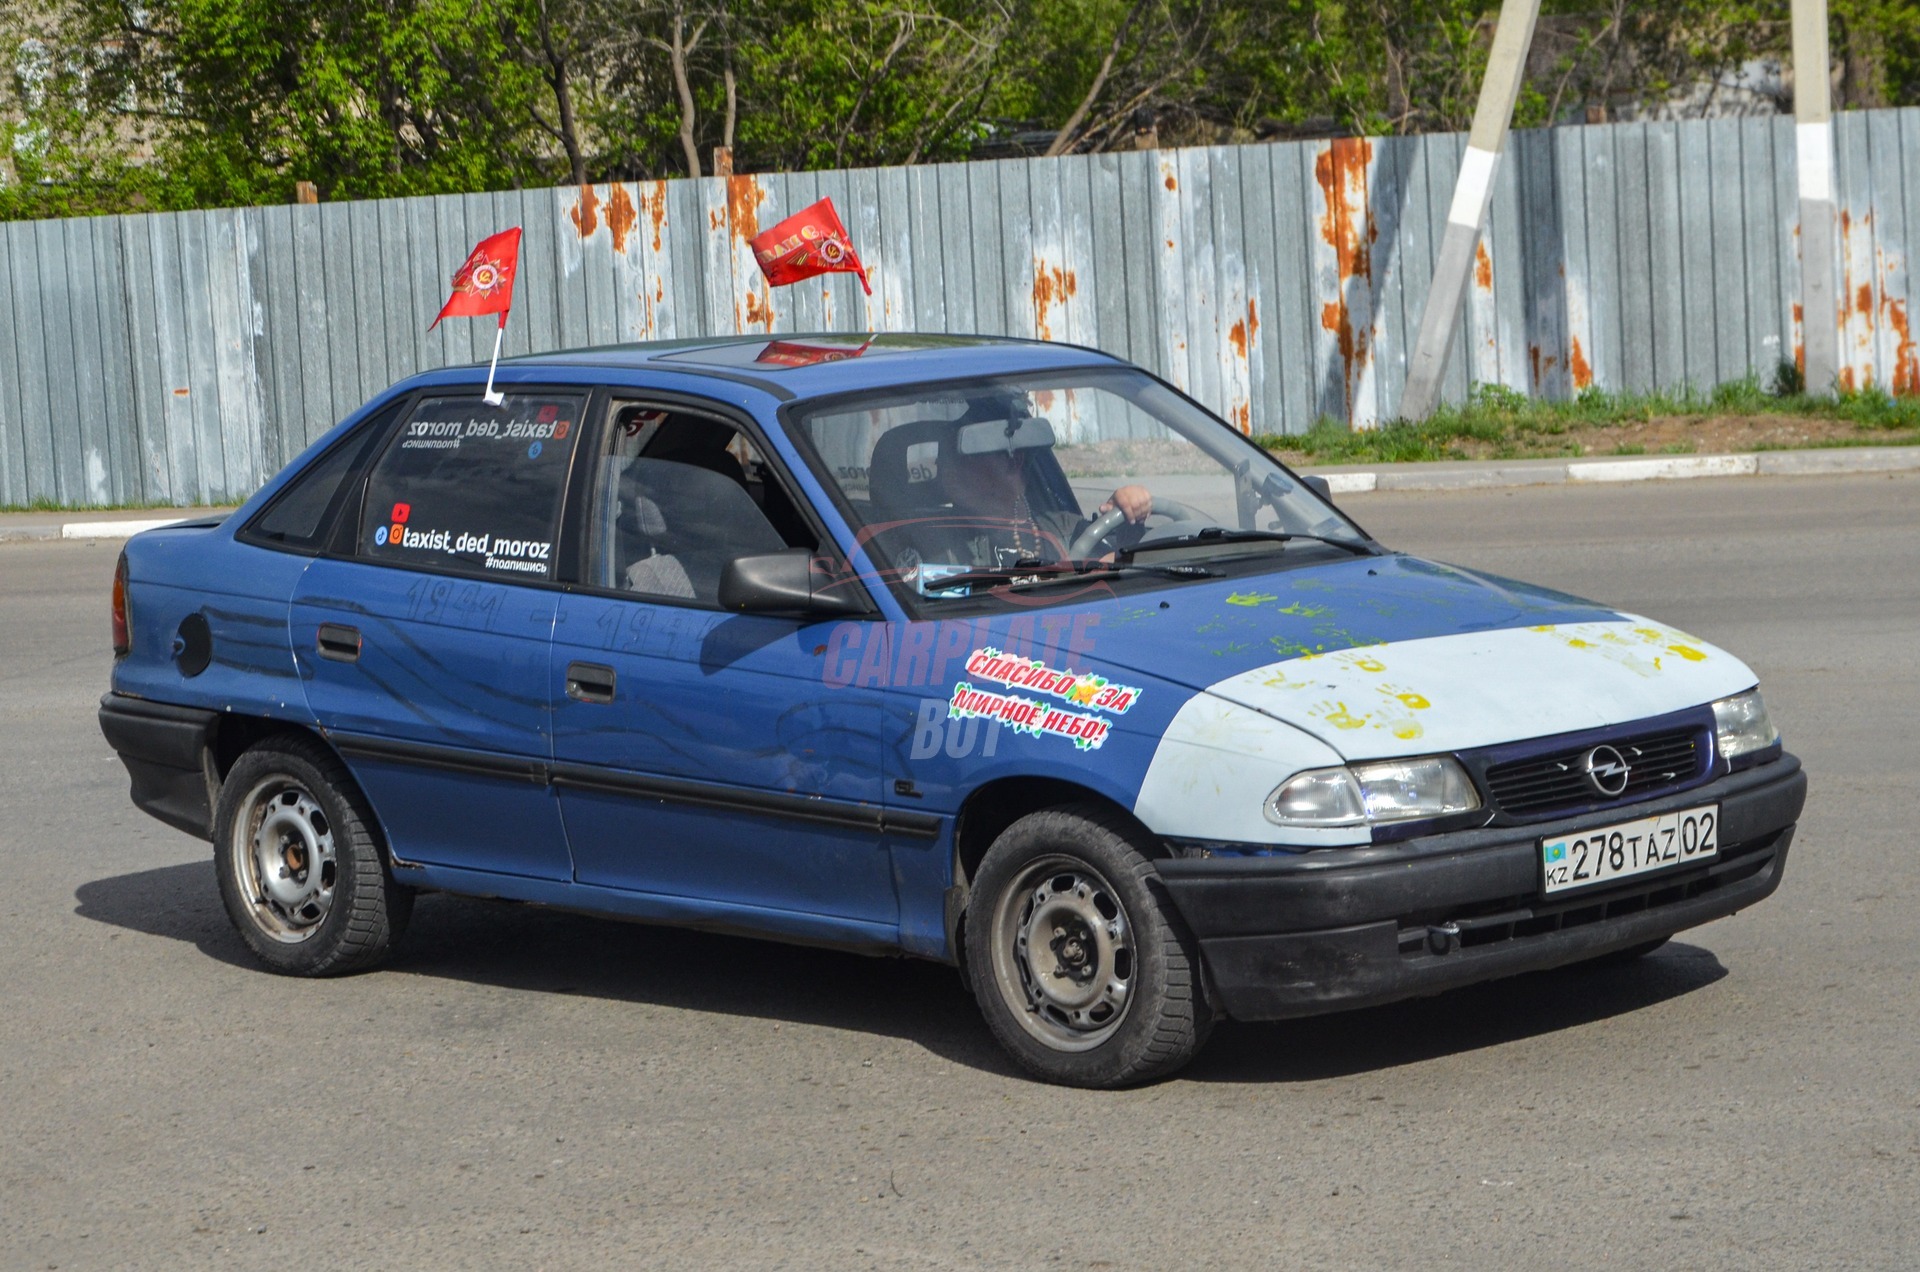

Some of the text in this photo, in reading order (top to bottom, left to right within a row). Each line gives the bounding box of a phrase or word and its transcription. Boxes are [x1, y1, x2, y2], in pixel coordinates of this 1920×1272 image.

[403, 527, 551, 559] taxist_ded_moroz
[485, 556, 547, 574] #подпишись
[968, 653, 1133, 713] СПАСИБО ЗА
[952, 687, 1109, 742] МИРНОЕ НЕБО!
[1546, 866, 1569, 887] KZ
